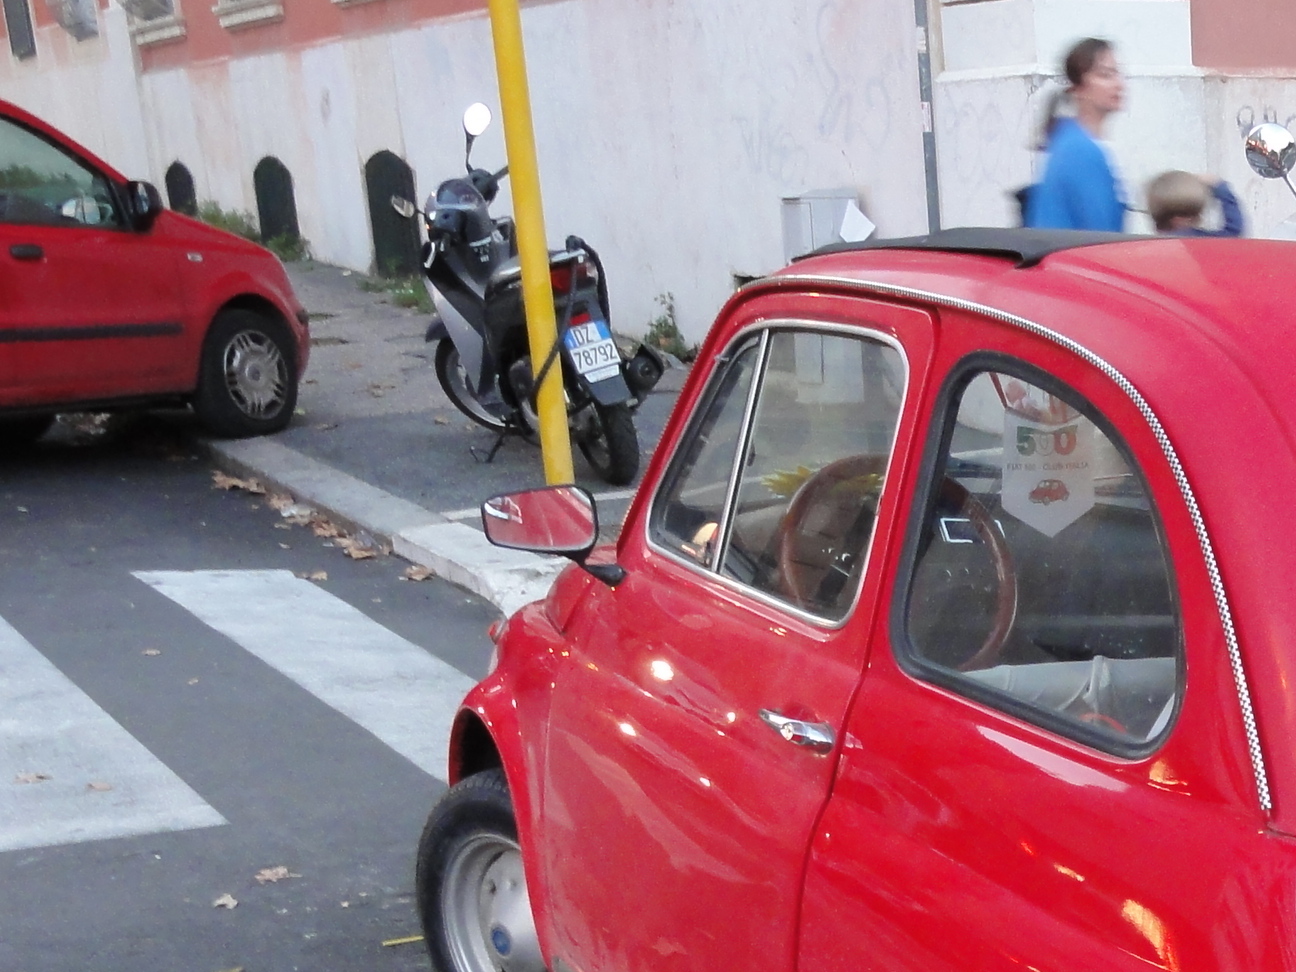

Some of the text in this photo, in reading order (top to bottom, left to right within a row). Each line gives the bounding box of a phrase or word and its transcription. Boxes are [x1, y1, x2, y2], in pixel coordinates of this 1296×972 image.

[573, 326, 593, 346] DZ
[573, 343, 617, 370] 78792
[1016, 425, 1078, 457] 500
